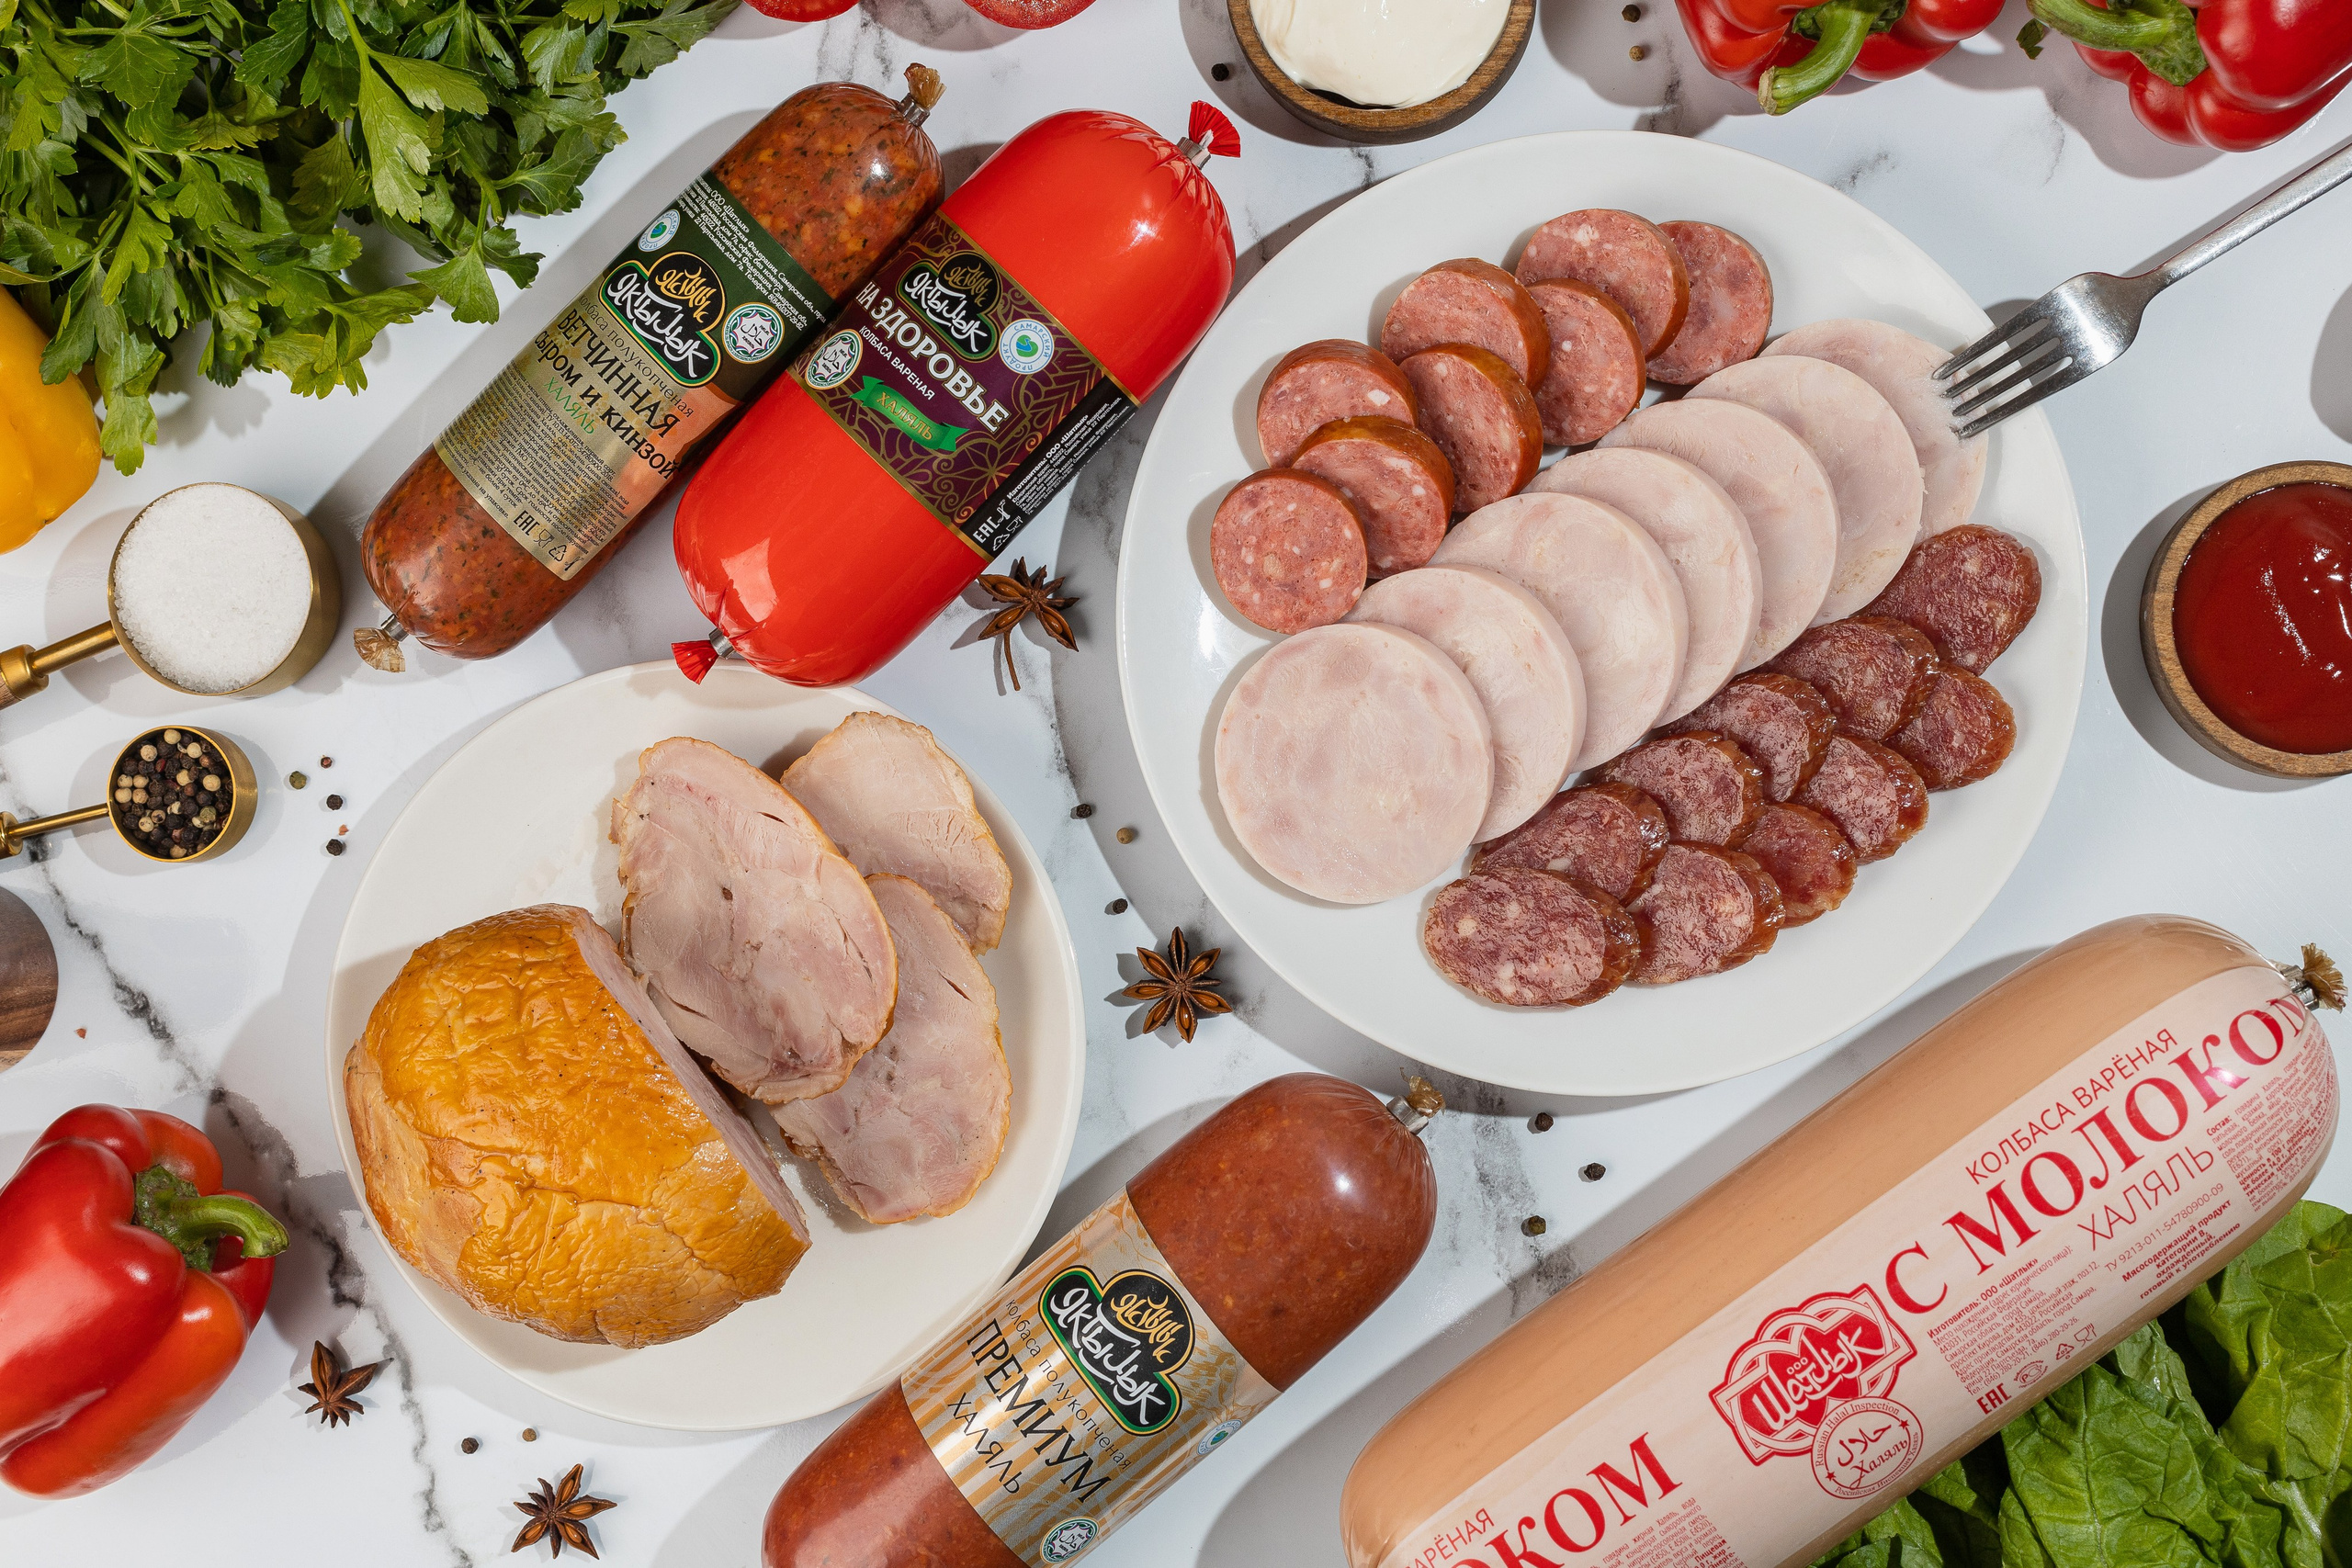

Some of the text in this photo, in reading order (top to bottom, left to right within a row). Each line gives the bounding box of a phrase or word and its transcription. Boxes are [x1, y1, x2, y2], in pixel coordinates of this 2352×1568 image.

[709, 189, 725, 206] ООО
[719, 224, 732, 237] дом
[736, 243, 753, 261] офис
[752, 256, 765, 269] без
[724, 250, 737, 263] дом
[741, 269, 769, 296] Телефон
[775, 272, 805, 301] Самарская
[576, 293, 693, 420] колбаса полукопченая
[854, 281, 1012, 433] НА ЗДОРОВЬЕ
[858, 325, 935, 401] КОЛБАСА ВАРЕНАЯ
[1002, 344, 1033, 370] ПРОДУКТ
[1014, 322, 1051, 358] САМАРСКИЙ
[533, 330, 678, 480] сыром и кинзой
[543, 376, 599, 435] ХАЛЯЛЬ
[557, 310, 681, 438] ВЕТЧИННАЯ
[875, 390, 937, 442] ХАЛЯЛЬ
[1006, 457, 1047, 499] Изготовитель:
[1045, 442, 1061, 459] ООО
[1964, 1026, 2177, 1185] КОЛБАСА ВАРЁНАЯ
[2205, 1115, 2232, 1136] Состав:
[2233, 1091, 2260, 1116] говядина
[2217, 1123, 2247, 1153] молочного
[2075, 1137, 2218, 1250] ХАЛЯЛЬ
[2104, 1181, 2225, 1273] ТУ 9213-011-54780900-09
[2121, 1199, 2233, 1282] Мясосодержащий продукт
[2154, 1235, 2199, 1269] категории
[2154, 1232, 2216, 1279] охлажденный,
[1885, 1240, 1945, 1312] С
[2139, 1270, 2175, 1300] готовый
[2180, 1222, 2241, 1269] употреблению
[1927, 1256, 2039, 1339] Изготовитель: ООО «Шатлык»
[1932, 1244, 2074, 1347] Место нахождения (адрес юридического лица):
[1938, 1284, 2034, 1355] 443031, Российская Федерация,
[1943, 1288, 2046, 1363] Самарская область, город Самара,
[1950, 1347, 1978, 1371] проспект
[1976, 1329, 2002, 1351] Кирова,
[2000, 1321, 2016, 1334] дом
[2013, 1312, 2028, 1325] 435,
[2027, 1287, 2063, 1314] цокольный
[2061, 1276, 2077, 1292] этаж,
[1953, 1290, 2074, 1377] Адрес производства: 443022, Российская
[1959, 1354, 1997, 1384] Федерация,
[1995, 1332, 2029, 1359] Самарская
[2027, 1314, 2053, 1337] область,
[2052, 1302, 2072, 1319] город
[2070, 1284, 2097, 1305] Самара,
[1963, 1374, 1984, 1391] улица
[1982, 1368, 1992, 1377] 22
[1990, 1343, 2028, 1372] Партсъезда,
[2026, 1337, 2037, 1347] 7а.
[1968, 1382, 1984, 1396] Тел.:
[1982, 1371, 2001, 1386] (846)
[1998, 1348, 2031, 1374] 280-20-21,
[2030, 1337, 2049, 1353] (846)
[965, 1318, 1112, 1503] ПРЕМИУМ
[1001, 1298, 1132, 1471] колбаса полукопченая
[945, 1392, 1021, 1495] ХАЛЯЛЬ
[1815, 1402, 1899, 1466] Russian Halal Inspection
[1838, 1424, 1891, 1466] حلال
[1849, 1439, 1908, 1488] Халяль
[1601, 1496, 1697, 1564] говядина жирная Халяль, вода
[1624, 1504, 1702, 1560] концентрат сывороточного
[1672, 1545, 1690, 1560] вкуса
[1692, 1525, 1718, 1546] аромата
[1687, 1511, 1707, 1528] смесь,
[1693, 1537, 1727, 1563] Пищевая
